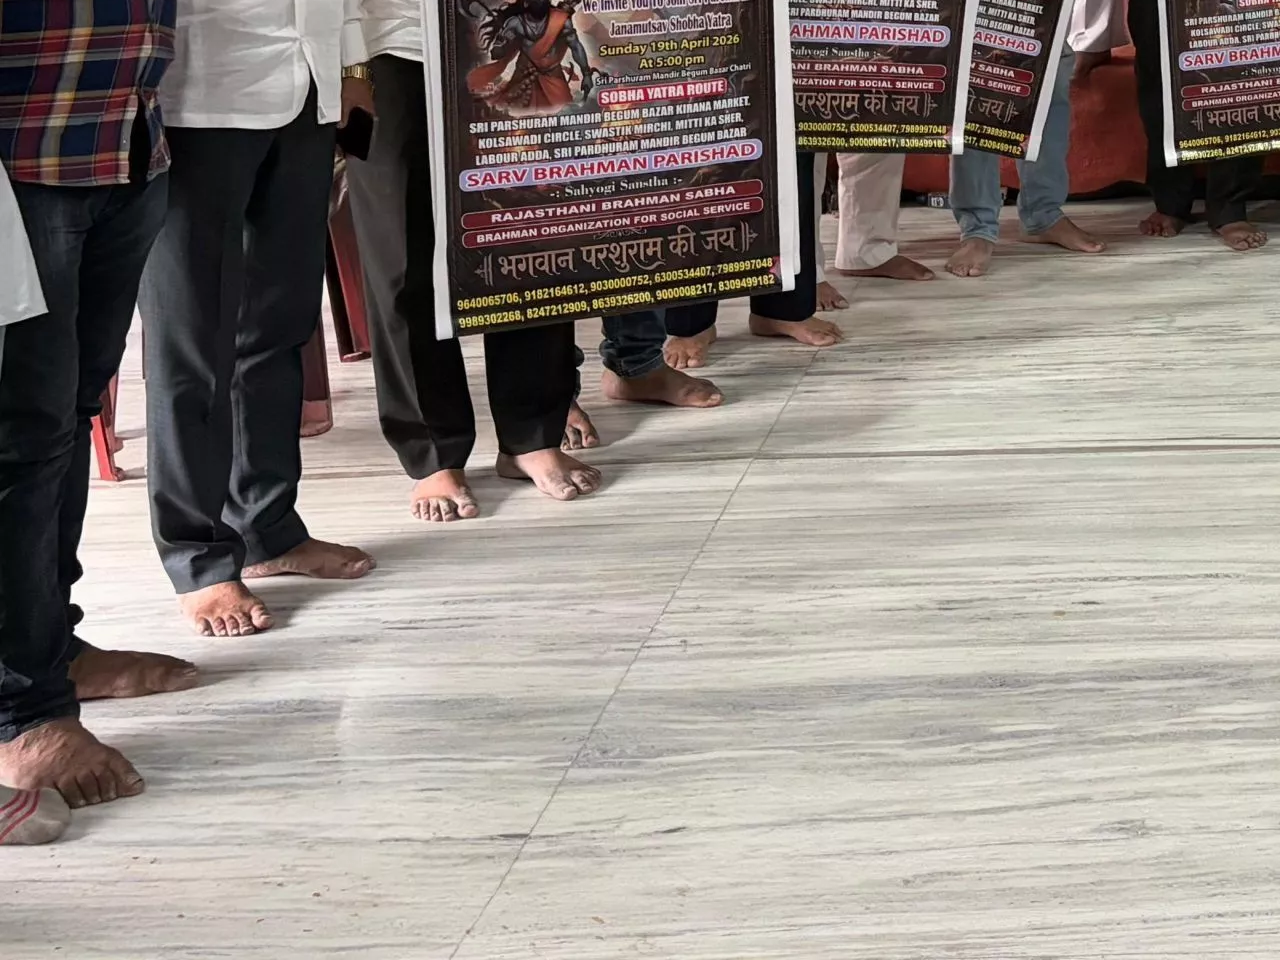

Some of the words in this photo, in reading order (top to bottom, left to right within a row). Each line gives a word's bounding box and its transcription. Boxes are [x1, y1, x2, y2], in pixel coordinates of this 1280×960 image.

[609, 17, 668, 38] Janamutsav
[669, 14, 704, 31] Shobha
[707, 13, 732, 28] Yatra
[599, 42, 646, 57] Sunday
[650, 39, 677, 51] 19th
[680, 36, 709, 51] April
[712, 33, 740, 45] 2026
[639, 58, 653, 69] At
[655, 56, 682, 67] 5:00
[685, 55, 704, 67] pm
[1184, 51, 1224, 67] SARV
[600, 88, 643, 104] SOBHA
[647, 84, 683, 99] YATRA
[687, 80, 724, 94] ROUTE
[466, 167, 528, 188] SARV
[532, 155, 648, 182] BRAHMAN
[652, 142, 756, 168] PARISHAD
